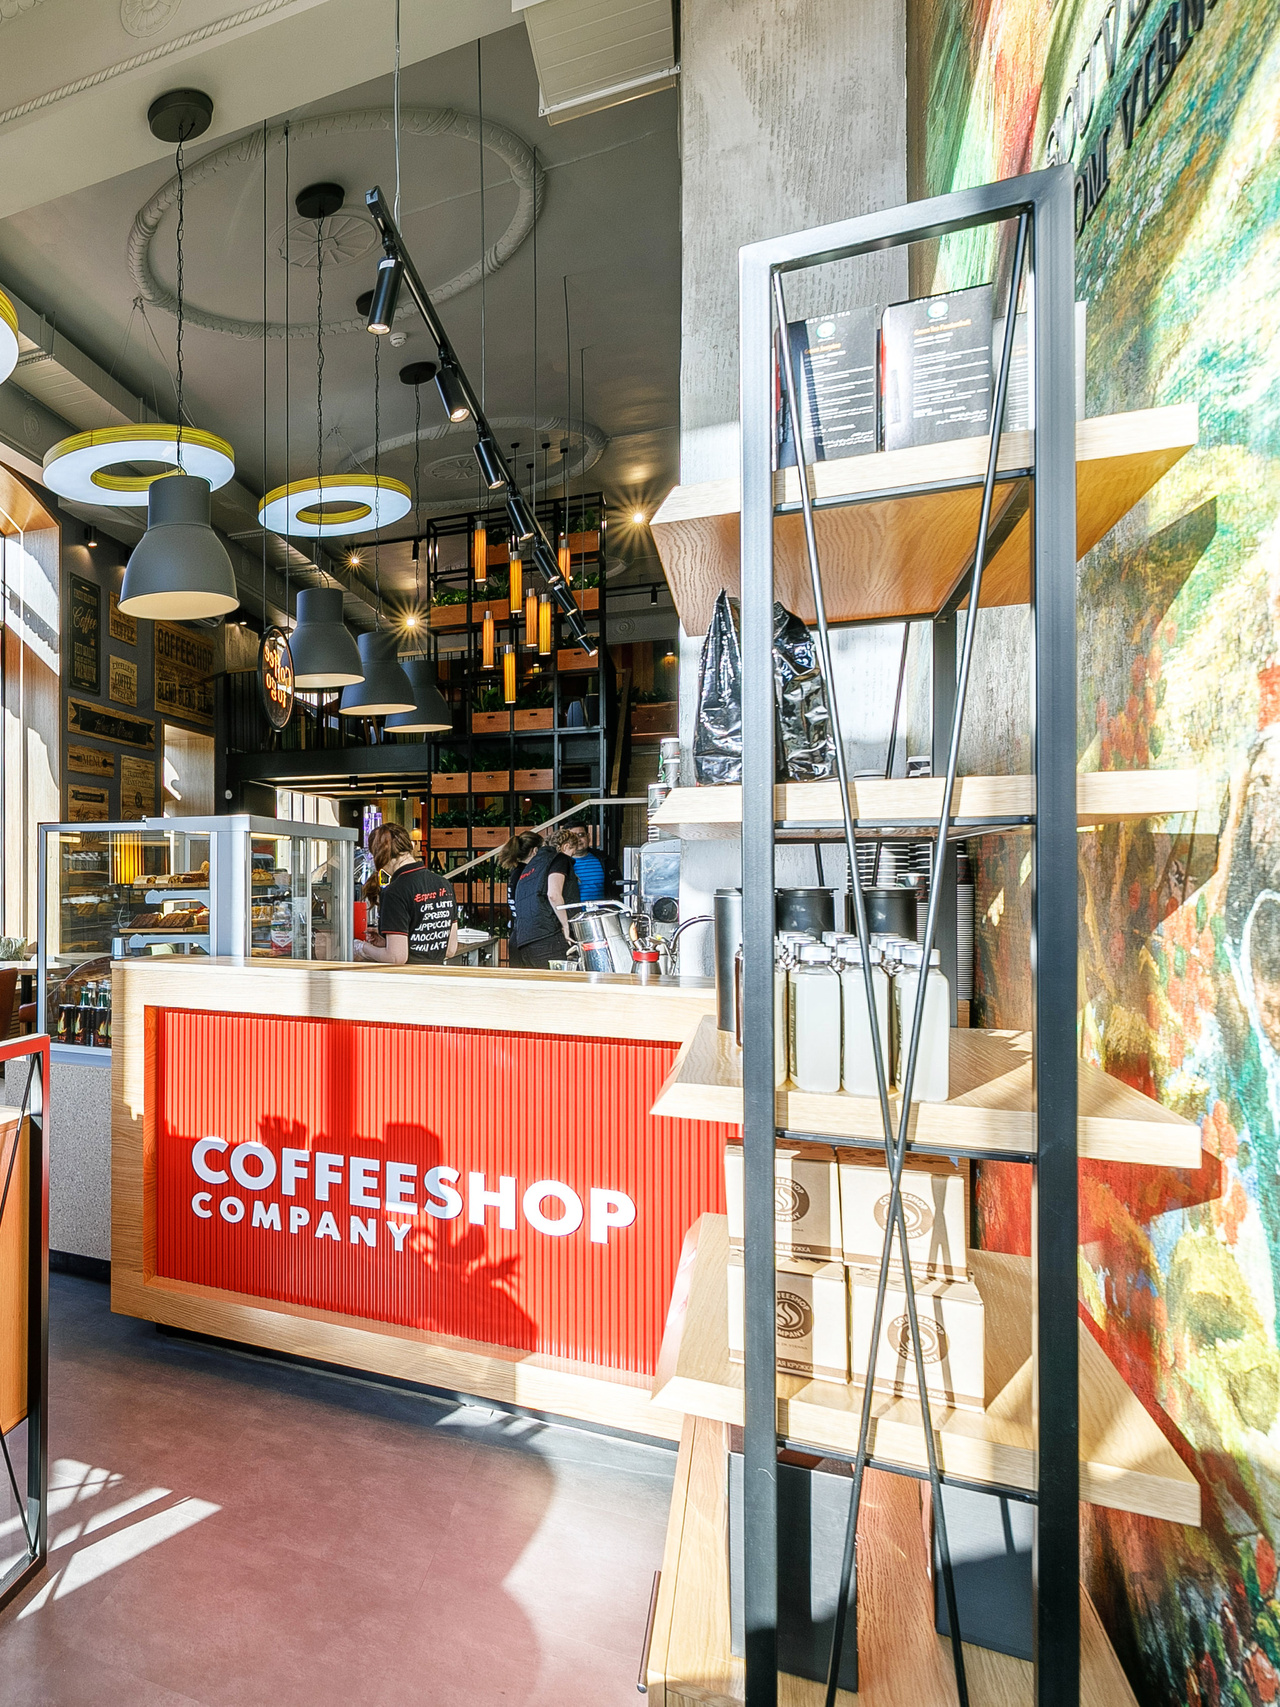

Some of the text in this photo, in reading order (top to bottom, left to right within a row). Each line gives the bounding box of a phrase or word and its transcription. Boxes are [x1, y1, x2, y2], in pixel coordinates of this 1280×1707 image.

[73, 606, 97, 634] Coffee
[158, 629, 213, 673] COFFEESHOP
[114, 672, 132, 690] COFFEE
[423, 911, 450, 921] SPRESSO
[191, 1136, 637, 1244] COFFEESHOP
[191, 1191, 412, 1252] COMPANY
[777, 1328, 805, 1339] MPANY
